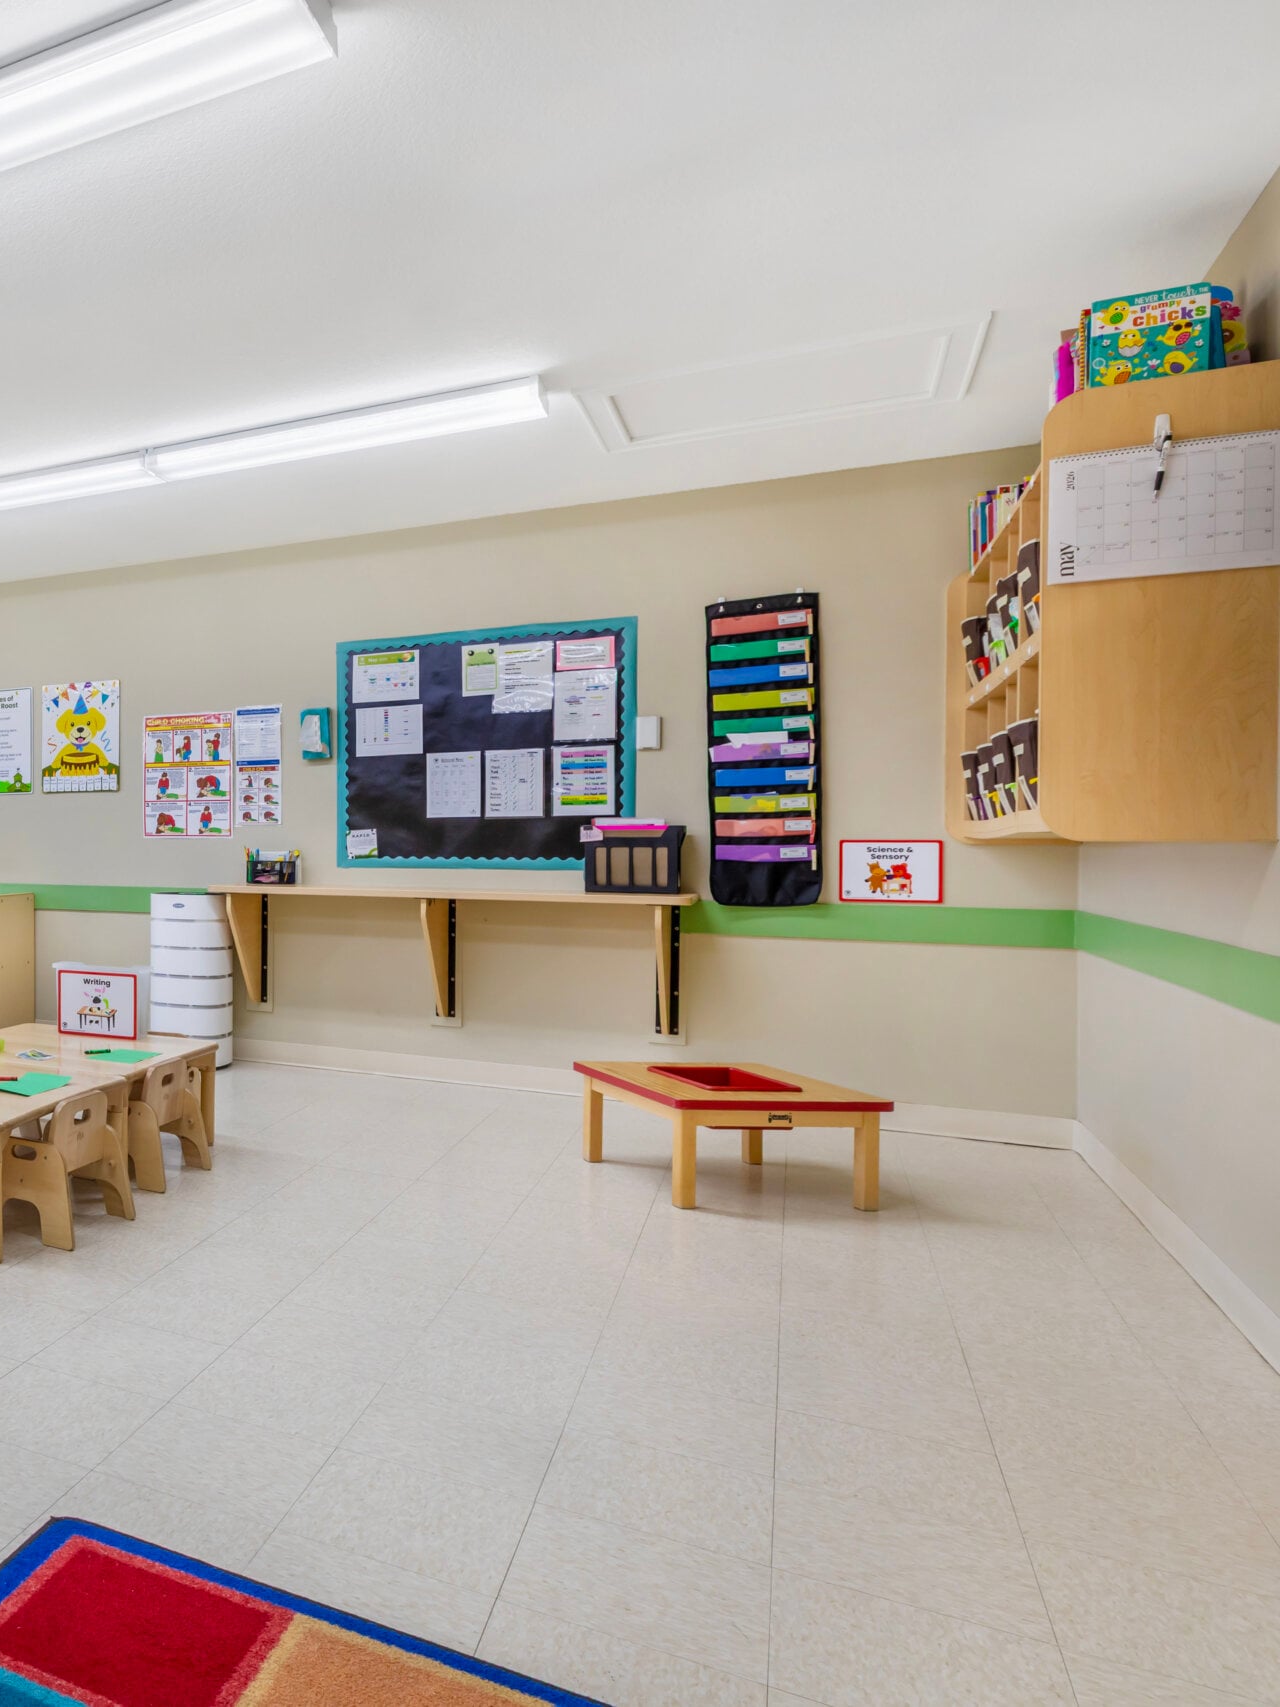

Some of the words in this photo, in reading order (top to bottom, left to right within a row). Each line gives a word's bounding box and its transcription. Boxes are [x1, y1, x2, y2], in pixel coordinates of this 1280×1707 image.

[1134, 295, 1158, 305] NEVER
[1161, 286, 1197, 301] touch
[1140, 299, 1182, 314] grumpy
[1132, 304, 1207, 328] chicks
[1066, 471, 1075, 492] 2026
[1060, 542, 1080, 577] may
[0, 702, 19, 710] Roost
[870, 853, 910, 861] Sensory
[83, 978, 111, 988] Writing
